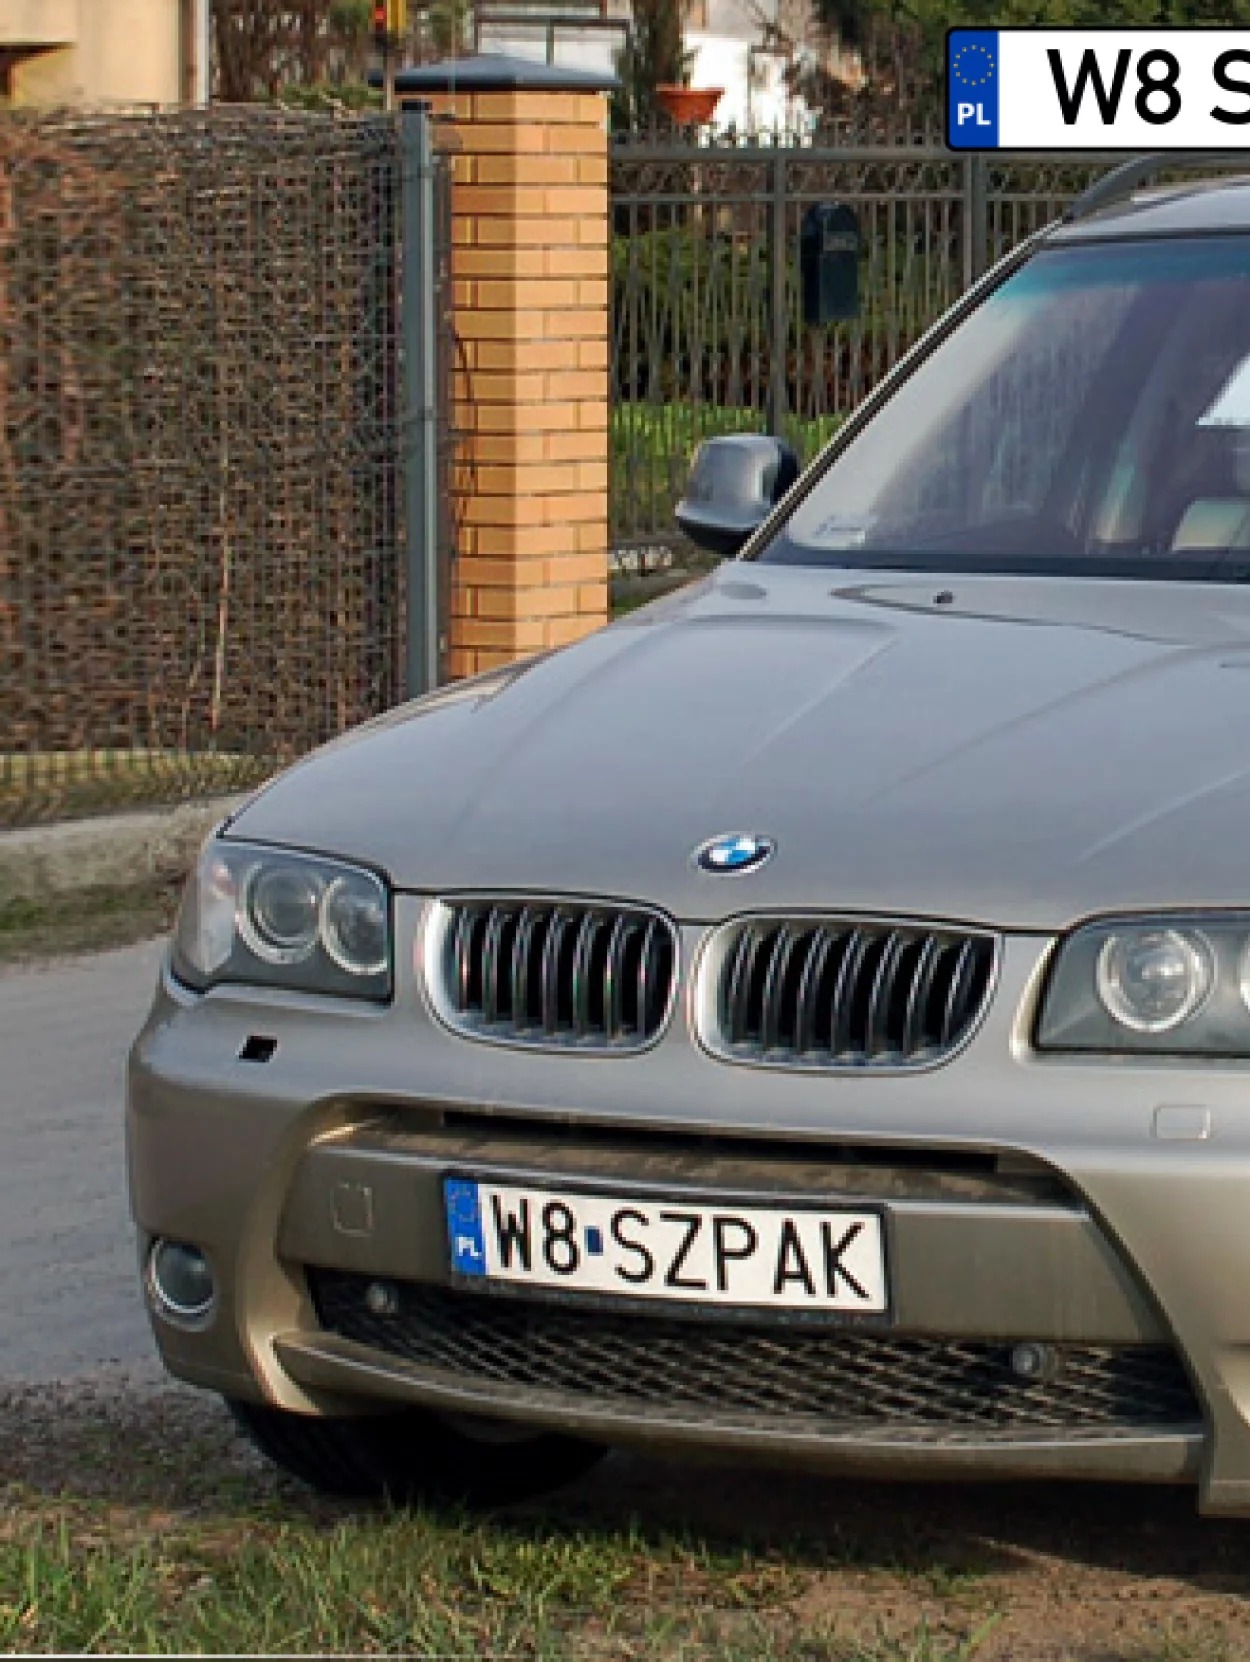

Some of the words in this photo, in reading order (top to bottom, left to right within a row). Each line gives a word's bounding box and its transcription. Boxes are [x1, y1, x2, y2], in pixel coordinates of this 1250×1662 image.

[457, 1236, 480, 1257] PL
[490, 1194, 580, 1274] W8
[611, 1208, 871, 1300] SZPAK
